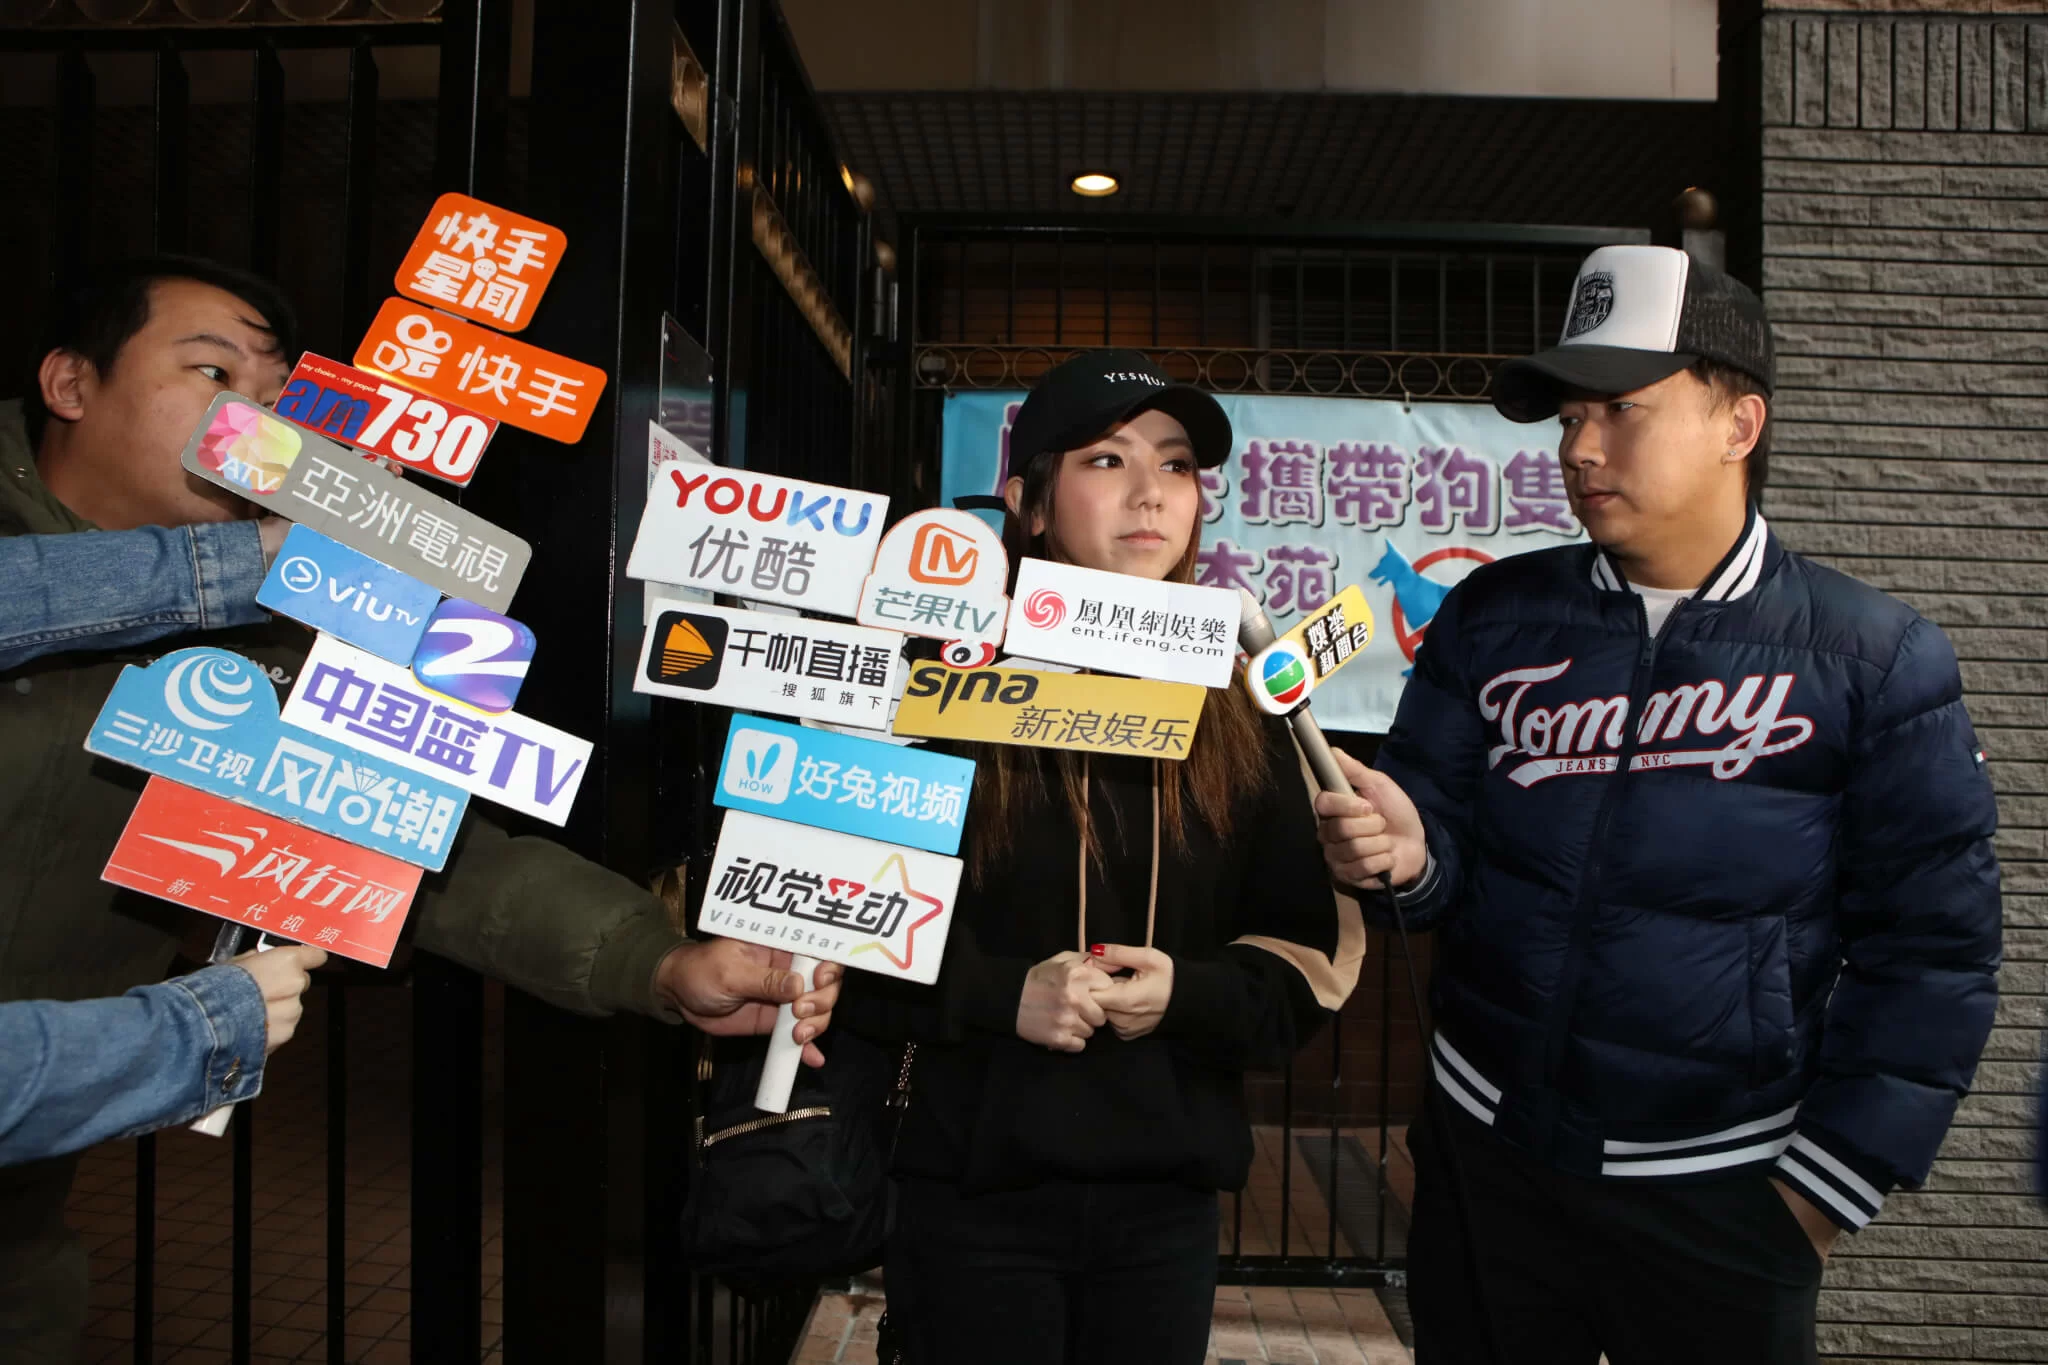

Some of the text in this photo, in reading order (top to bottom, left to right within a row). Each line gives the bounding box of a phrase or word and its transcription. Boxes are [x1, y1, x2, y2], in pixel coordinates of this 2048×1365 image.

[434, 212, 547, 277] 快手
[410, 251, 529, 324] 星闻
[457, 345, 585, 417] 快手
[1103, 372, 1166, 387] YESHU
[275, 378, 489, 477] am730
[216, 454, 281, 493] ATV
[670, 469, 872, 538] YOUKU
[291, 456, 510, 594] 亞洲電視
[688, 523, 817, 597] 优酷
[874, 586, 998, 635] 芒果tv
[1071, 625, 1225, 657] ent.ifeng.com
[727, 628, 892, 688] 千帆直播
[907, 666, 1040, 715] sina
[782, 681, 883, 710] 搜狐旗下
[1010, 704, 1191, 752] 新浪娱乐
[1479, 657, 1814, 788] Tommy
[103, 709, 256, 784] 三沙卫视
[300, 661, 583, 807] 中国蓝TV
[1554, 753, 1672, 773] JEANS NYC
[738, 777, 774, 795] HOW
[795, 755, 965, 828] 好兔视频
[167, 878, 342, 945] 新一代视频
[240, 844, 408, 924] 风行网
[708, 908, 845, 950] VisualStar
